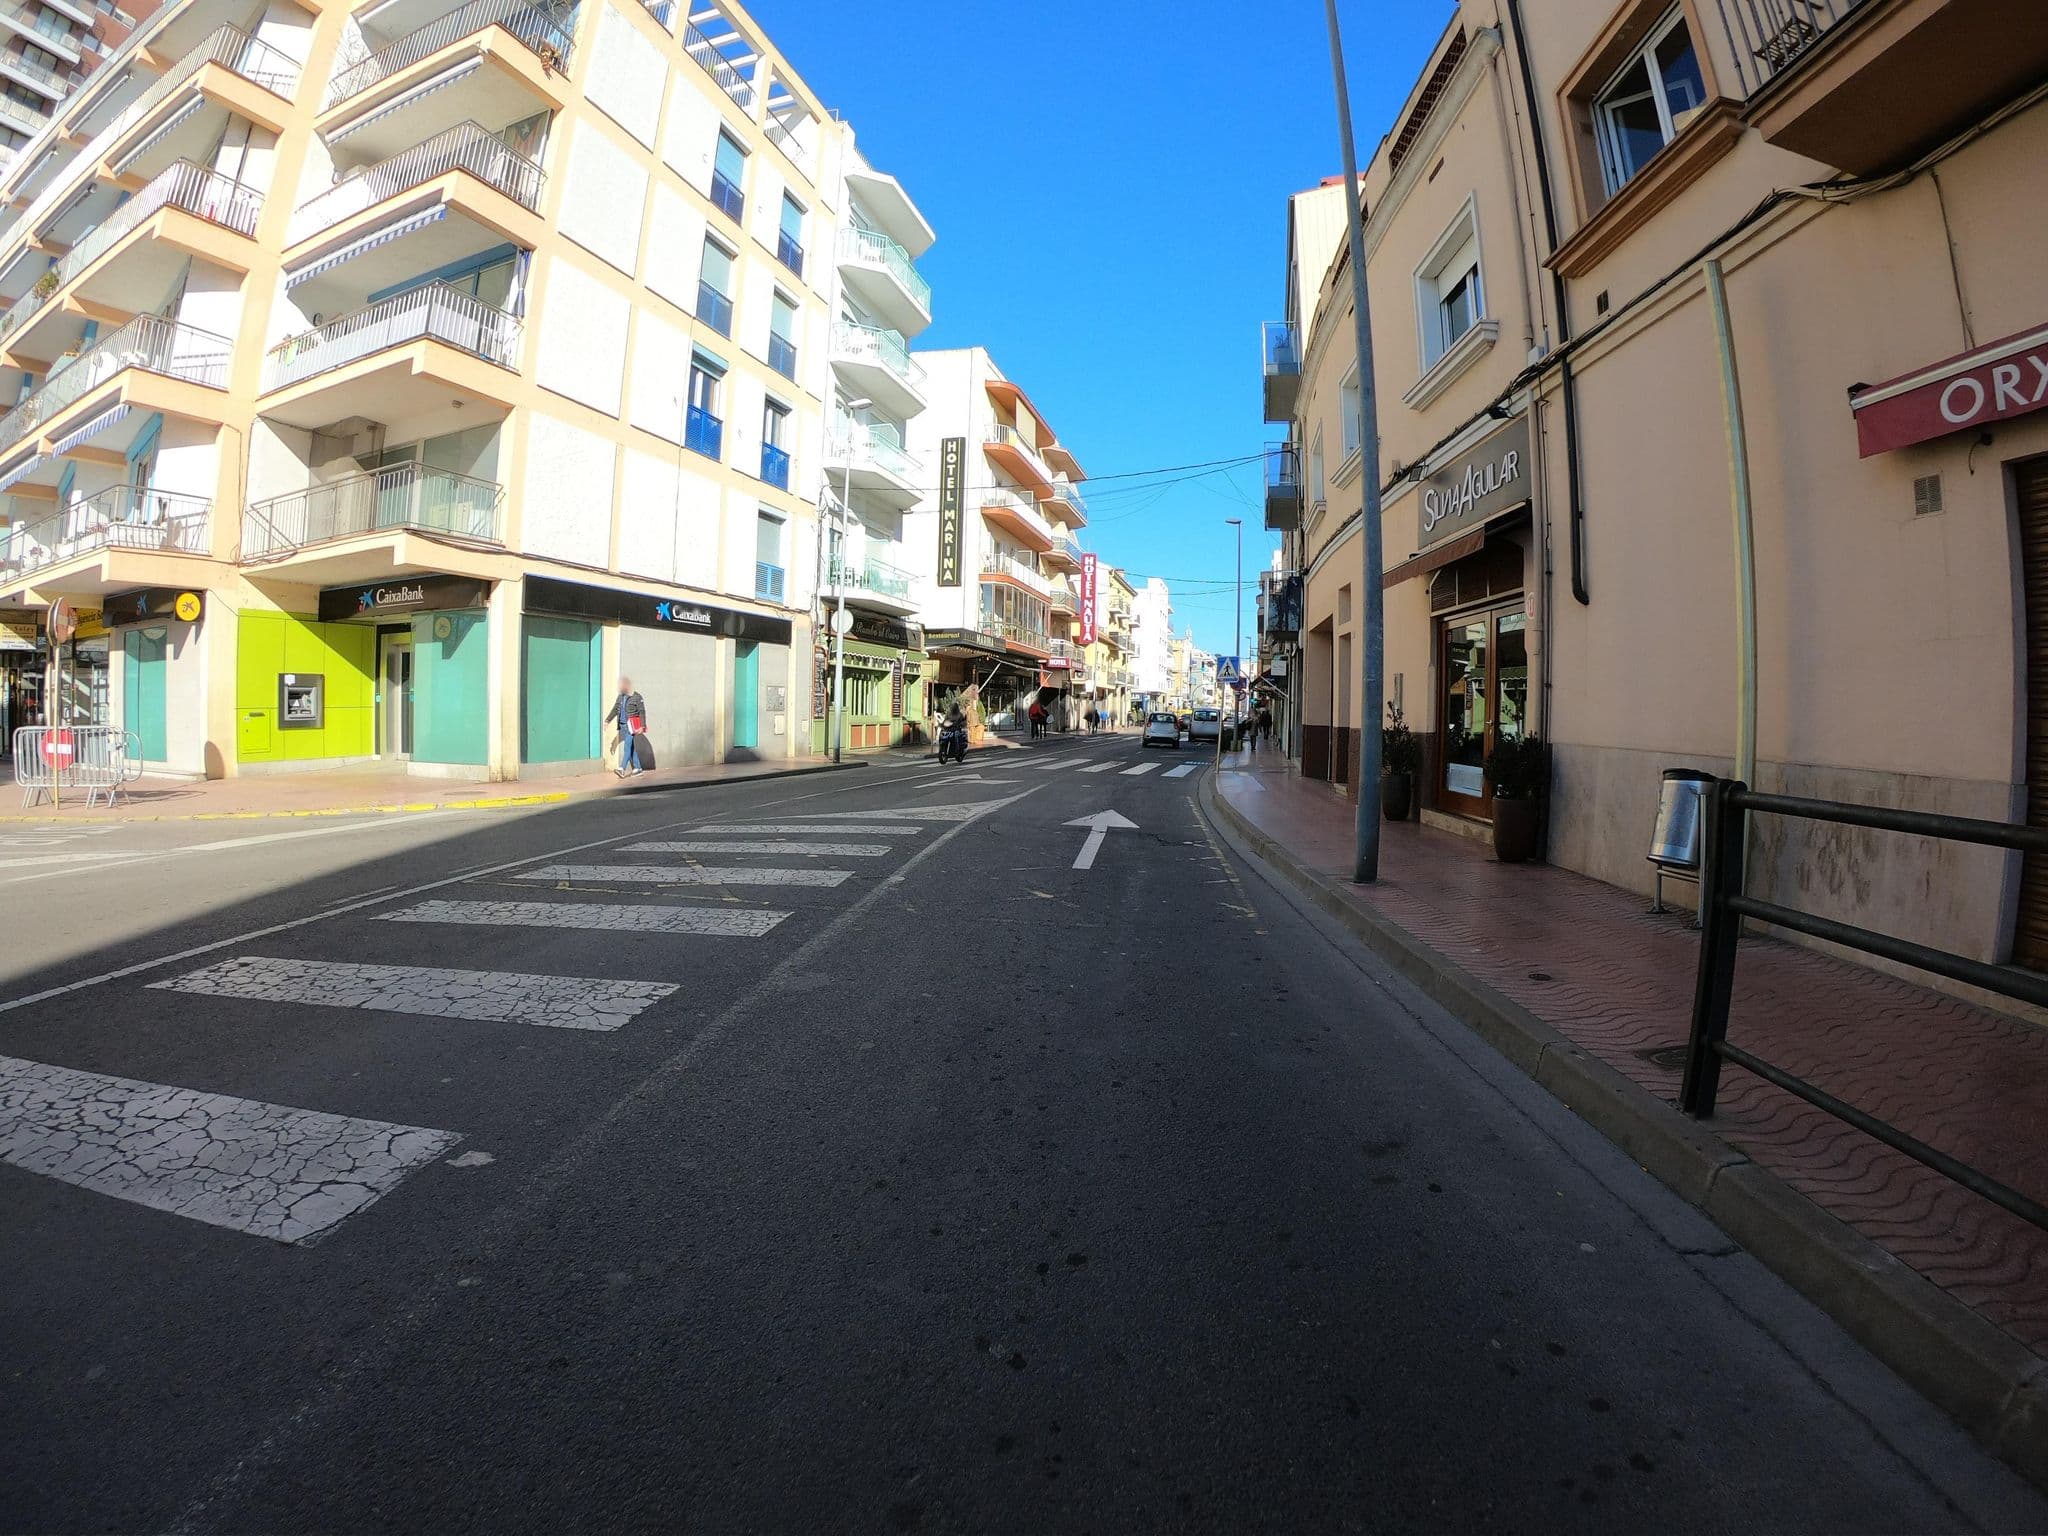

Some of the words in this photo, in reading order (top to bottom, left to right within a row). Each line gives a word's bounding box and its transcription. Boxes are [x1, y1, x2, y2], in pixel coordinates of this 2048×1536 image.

[946, 441, 957, 502] HOTEL
[943, 511, 956, 581] MARINA
[376, 585, 424, 604] CaixaBank
[1084, 556, 1095, 597] HOTEL
[672, 605, 711, 623] CaixaBank
[1082, 599, 1094, 641] NAUTA
